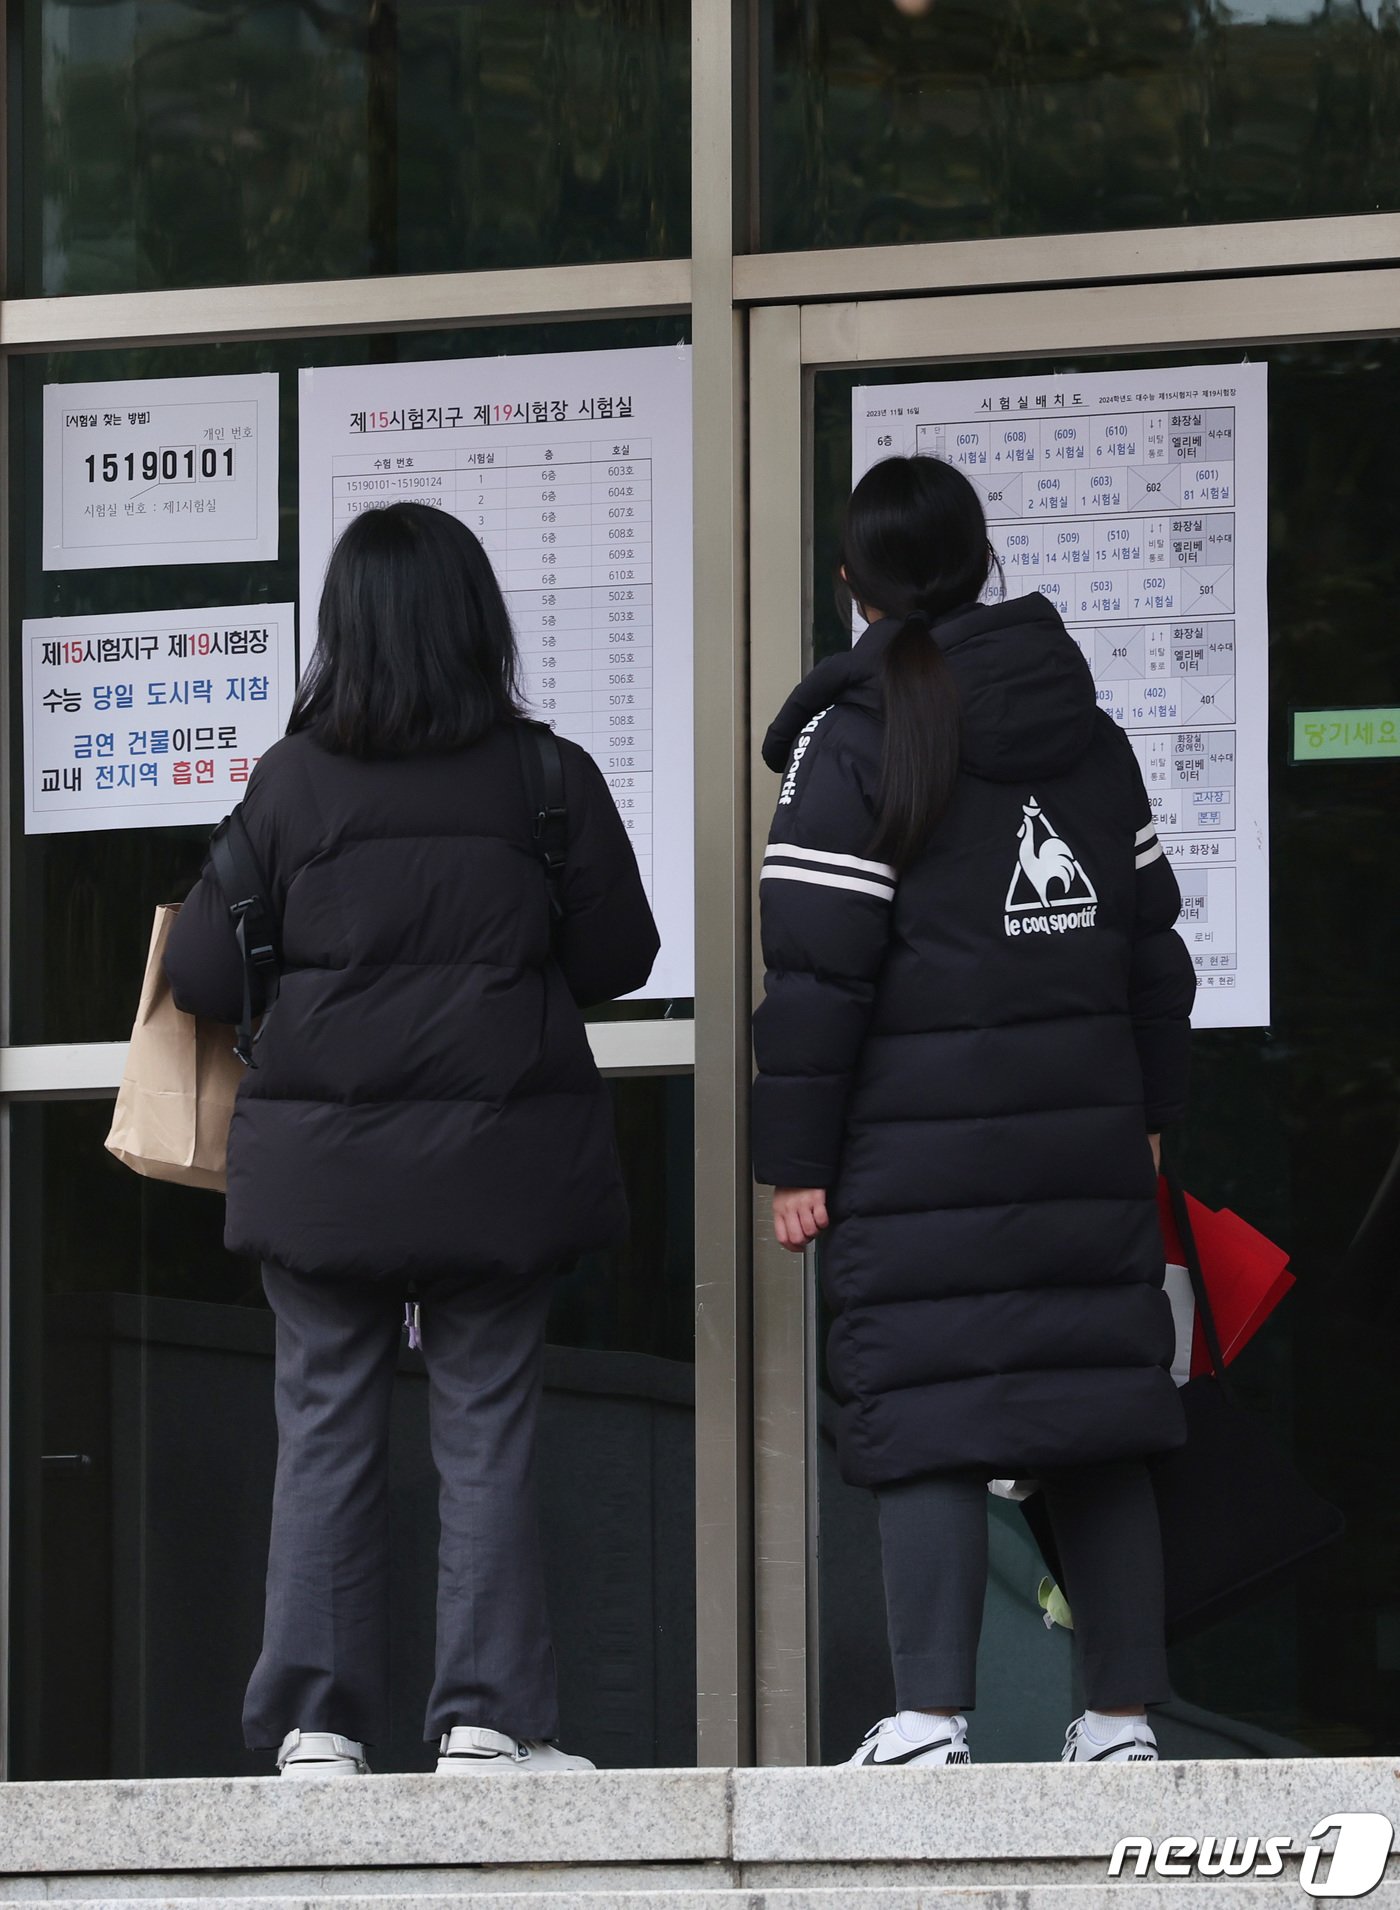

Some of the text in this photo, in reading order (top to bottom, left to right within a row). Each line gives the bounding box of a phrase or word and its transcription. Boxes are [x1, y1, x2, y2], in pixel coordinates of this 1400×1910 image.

[1099, 395, 1132, 404] 2024학년도
[1158, 391, 1199, 401] 제15시험지구
[1202, 388, 1236, 398] 제19시험장
[350, 396, 633, 432] 제15시험지구 제19시험장 시험실
[866, 407, 920, 417] 2023년 11월 16일
[66, 411, 150, 427] [시험실 찾는 방법]
[1171, 414, 1202, 427] 화장실
[203, 426, 253, 440] 개인 번호
[1004, 431, 1026, 444] (608)
[1054, 428, 1076, 441] (609)
[1105, 425, 1128, 438] (610)
[1208, 429, 1232, 439] 식수대
[877, 435, 893, 446] 6층
[956, 434, 979, 446] (607)
[1171, 435, 1202, 448] 엘리베
[995, 448, 1035, 462] 4 시험실
[1045, 446, 1084, 459] 5 시험실
[1096, 442, 1136, 455] 6 시험실
[1177, 447, 1197, 459] 이터
[374, 444, 630, 470] 수험 번호 시험실 층 호실
[958, 451, 987, 464] 시험실
[85, 448, 233, 483] 15190101
[541, 470, 557, 481] 6층
[607, 466, 635, 477] 603호
[1195, 470, 1219, 481] (601)
[1037, 479, 1060, 491] (604)
[1090, 476, 1113, 488] (603)
[1146, 482, 1161, 492] 602
[478, 487, 635, 505] 2 6층 604호
[988, 491, 1003, 501] 605
[1091, 492, 1120, 506] 시험실
[1184, 486, 1229, 500] 81 시험실
[84, 499, 216, 518] 시험실 번호 제1시험실
[1028, 495, 1068, 510] 2 시험실
[478, 508, 635, 526] 3 6층 607호
[1172, 520, 1203, 533] 화장실
[541, 528, 635, 544] 6층 608호
[1006, 535, 1029, 548] (508)
[1057, 532, 1080, 545] (509)
[1107, 529, 1130, 541] (510)
[1208, 534, 1232, 543] 식수대
[1172, 540, 1203, 552] 엘리베
[541, 549, 635, 564] 6층 609호
[1011, 552, 1040, 566] 시험실
[1046, 549, 1090, 563] 14 시험실
[1096, 547, 1141, 561] 15 시험실
[1178, 551, 1198, 563] 이터
[541, 570, 635, 585] 6층 610호
[1143, 578, 1165, 590] (502)
[1090, 581, 1113, 592] (503)
[1199, 585, 1214, 595] 501
[541, 591, 635, 606] 5층 502호
[1081, 601, 1087, 611] 8
[1092, 597, 1120, 611] 시험실
[1134, 595, 1174, 608] 7 시험실
[541, 611, 635, 627] 5층 503호
[541, 632, 635, 647] 5층 504호
[1173, 627, 1204, 640] 화장실
[41, 629, 269, 666] 제15시험지구 제19시험장
[1112, 648, 1127, 657] 410
[1209, 643, 1233, 653] 식수대
[541, 653, 635, 668] 5층 505호
[1174, 648, 1204, 661] 엘리베
[1179, 661, 1199, 672] 이터
[541, 674, 635, 689] 5층 506호
[43, 676, 270, 713] 수능 당일 도시락 지참
[1144, 687, 1167, 700] (402)
[1200, 695, 1215, 704] 401
[541, 695, 635, 710] 5층 507호
[1132, 704, 1177, 718] 16 시험실
[608, 715, 635, 726] 508호
[1177, 734, 1202, 744] 화장실
[1304, 720, 1398, 748] 당기세요
[74, 726, 238, 759] 금연 건물이므로
[608, 736, 635, 747] 509호
[1175, 743, 1205, 753] (장애인)
[608, 757, 635, 768] 510호
[1209, 753, 1233, 763] 식수대
[778, 735, 811, 806] sportif
[1174, 759, 1204, 771] 엘리베
[41, 760, 215, 792] 교내 전지역 흡연
[1180, 770, 1199, 781] 이터
[1189, 844, 1220, 856] 화장실
[1180, 908, 1199, 919] 이터
[1004, 905, 1098, 936] le coq sportif
[1194, 931, 1214, 943] 로비
